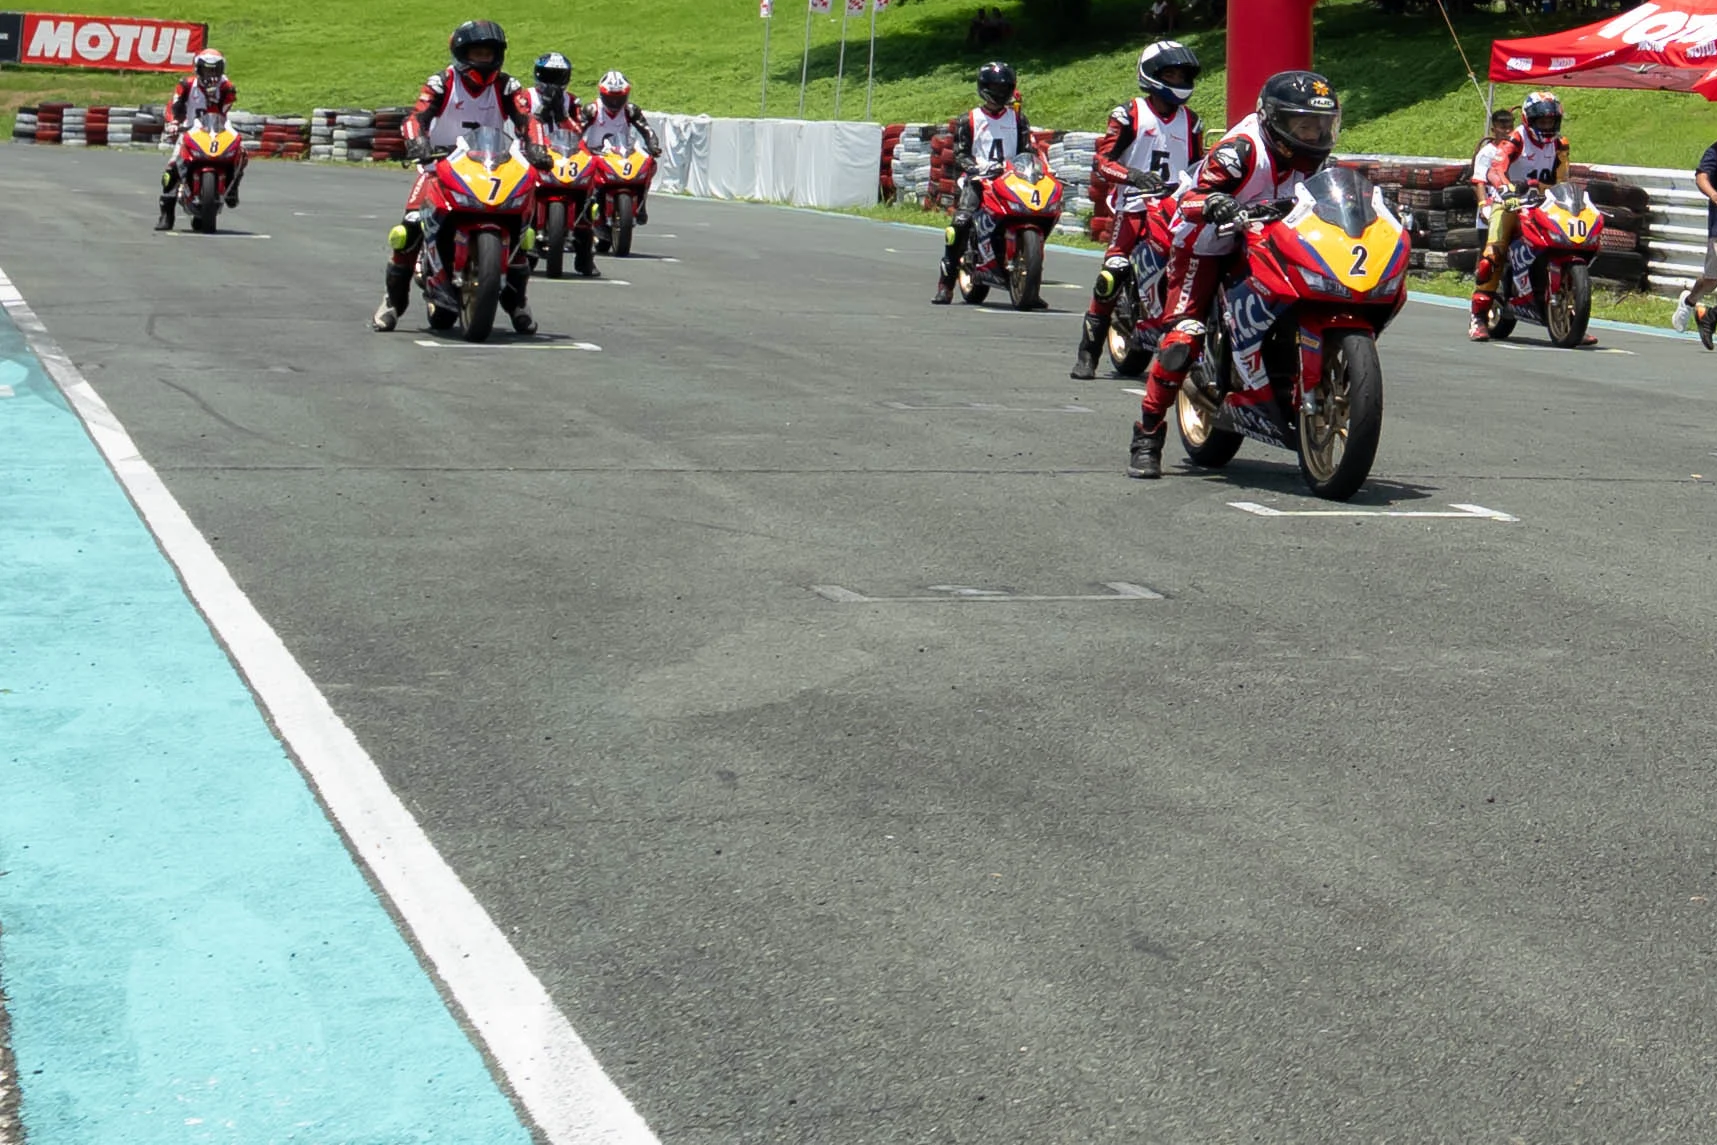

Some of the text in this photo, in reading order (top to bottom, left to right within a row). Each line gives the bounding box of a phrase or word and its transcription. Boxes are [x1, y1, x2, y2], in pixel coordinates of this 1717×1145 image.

[27, 20, 196, 65] MOTUL
[209, 140, 218, 154] 8
[622, 162, 632, 176] 9
[1150, 150, 1170, 182] 5
[488, 177, 501, 201] 7
[1030, 190, 1040, 206] 4
[1109, 211, 1123, 248] ONDA
[1567, 221, 1587, 237] 10
[1349, 245, 1368, 276] 2
